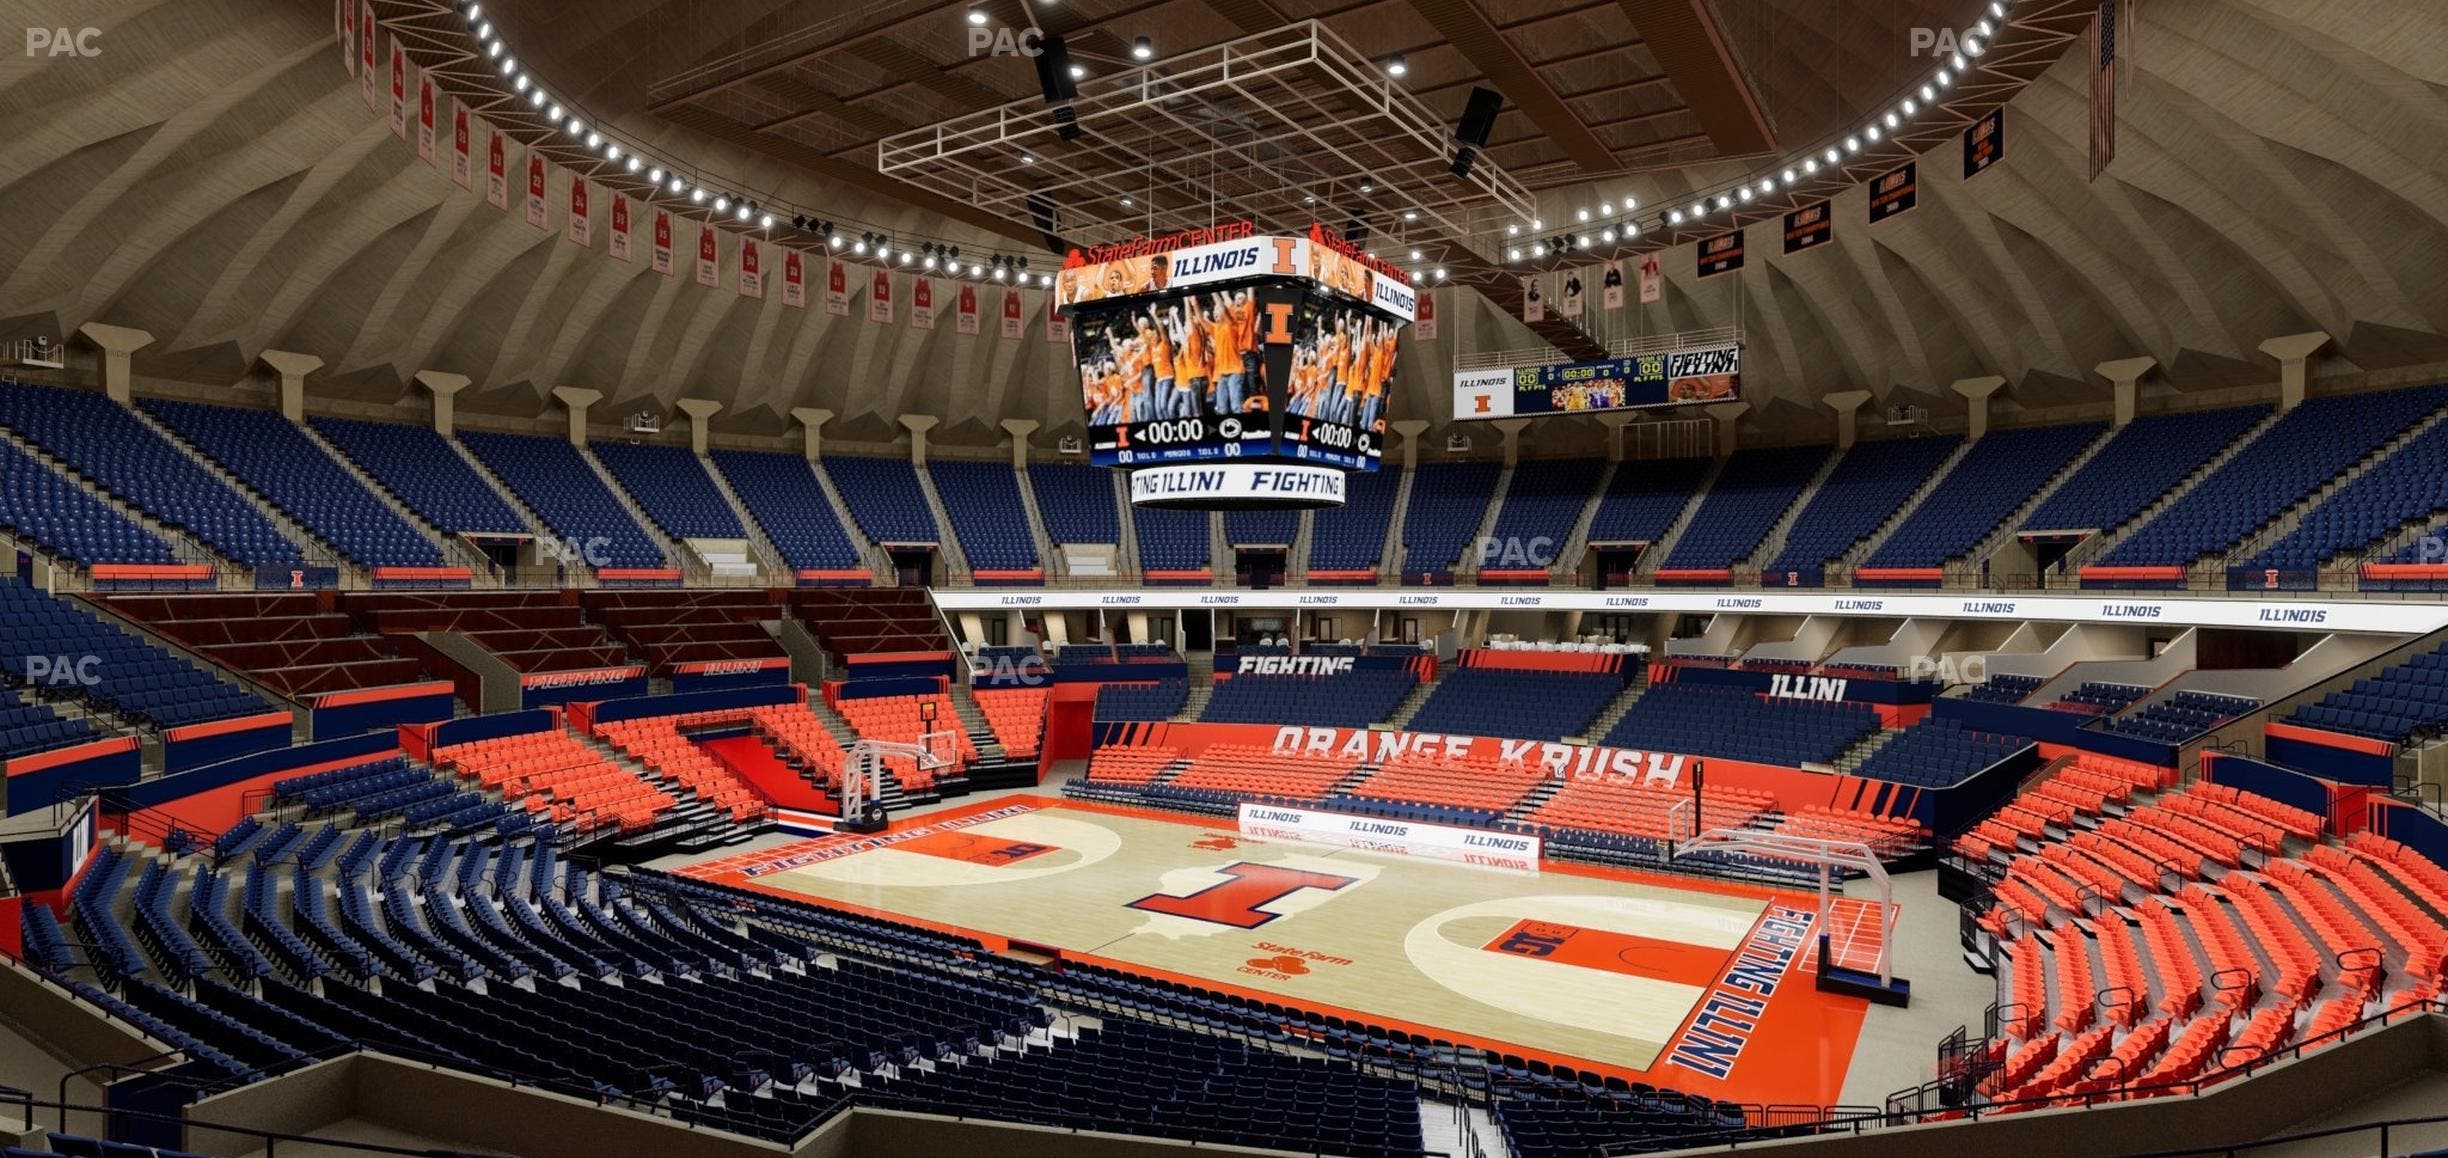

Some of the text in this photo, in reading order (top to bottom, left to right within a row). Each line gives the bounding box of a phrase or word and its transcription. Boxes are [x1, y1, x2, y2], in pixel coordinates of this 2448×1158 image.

[1174, 247, 1259, 277] ILLINOIS
[1376, 281, 1414, 312] ILLINOIS
[1565, 368, 1593, 378] 00:00
[1460, 377, 1507, 388] ILLINOIS
[1148, 419, 1203, 444] 00:00
[1320, 422, 1352, 448] 00:00
[1119, 450, 1133, 463] 00
[1224, 442, 1240, 457] 00
[1162, 471, 1226, 492] ILLINI
[1251, 471, 1339, 495] FIGHTING
[1001, 596, 1041, 605] ILLINOIS
[1102, 596, 1140, 605] ILLINOIS
[1200, 596, 1239, 605] ILLINOIS
[1299, 596, 1338, 605] ILLINOIS
[1399, 596, 1438, 605] ILLINOIS
[1500, 596, 1541, 605] ILLINOIS
[1605, 597, 1648, 606] ILLINOIS
[1716, 598, 1762, 608] ILLINOIS
[1834, 600, 1883, 610] ILLINOIS
[1963, 602, 2015, 613] ILLINOIS
[2102, 605, 2161, 617] ILLINOIS
[2258, 608, 2327, 623] ILLINOIS
[1238, 656, 1355, 675] FIGHTING
[1769, 674, 1847, 703] ILLINI
[1500, 738, 1684, 790] KRUSH
[1249, 809, 1302, 823] ILLINOIS
[1349, 821, 1407, 837] ILLINOIS
[1464, 834, 1529, 852] ILLINOIS
[1236, 966, 1292, 981] CENTER
[1665, 905, 1817, 1080] FIGHTING ILLINI
